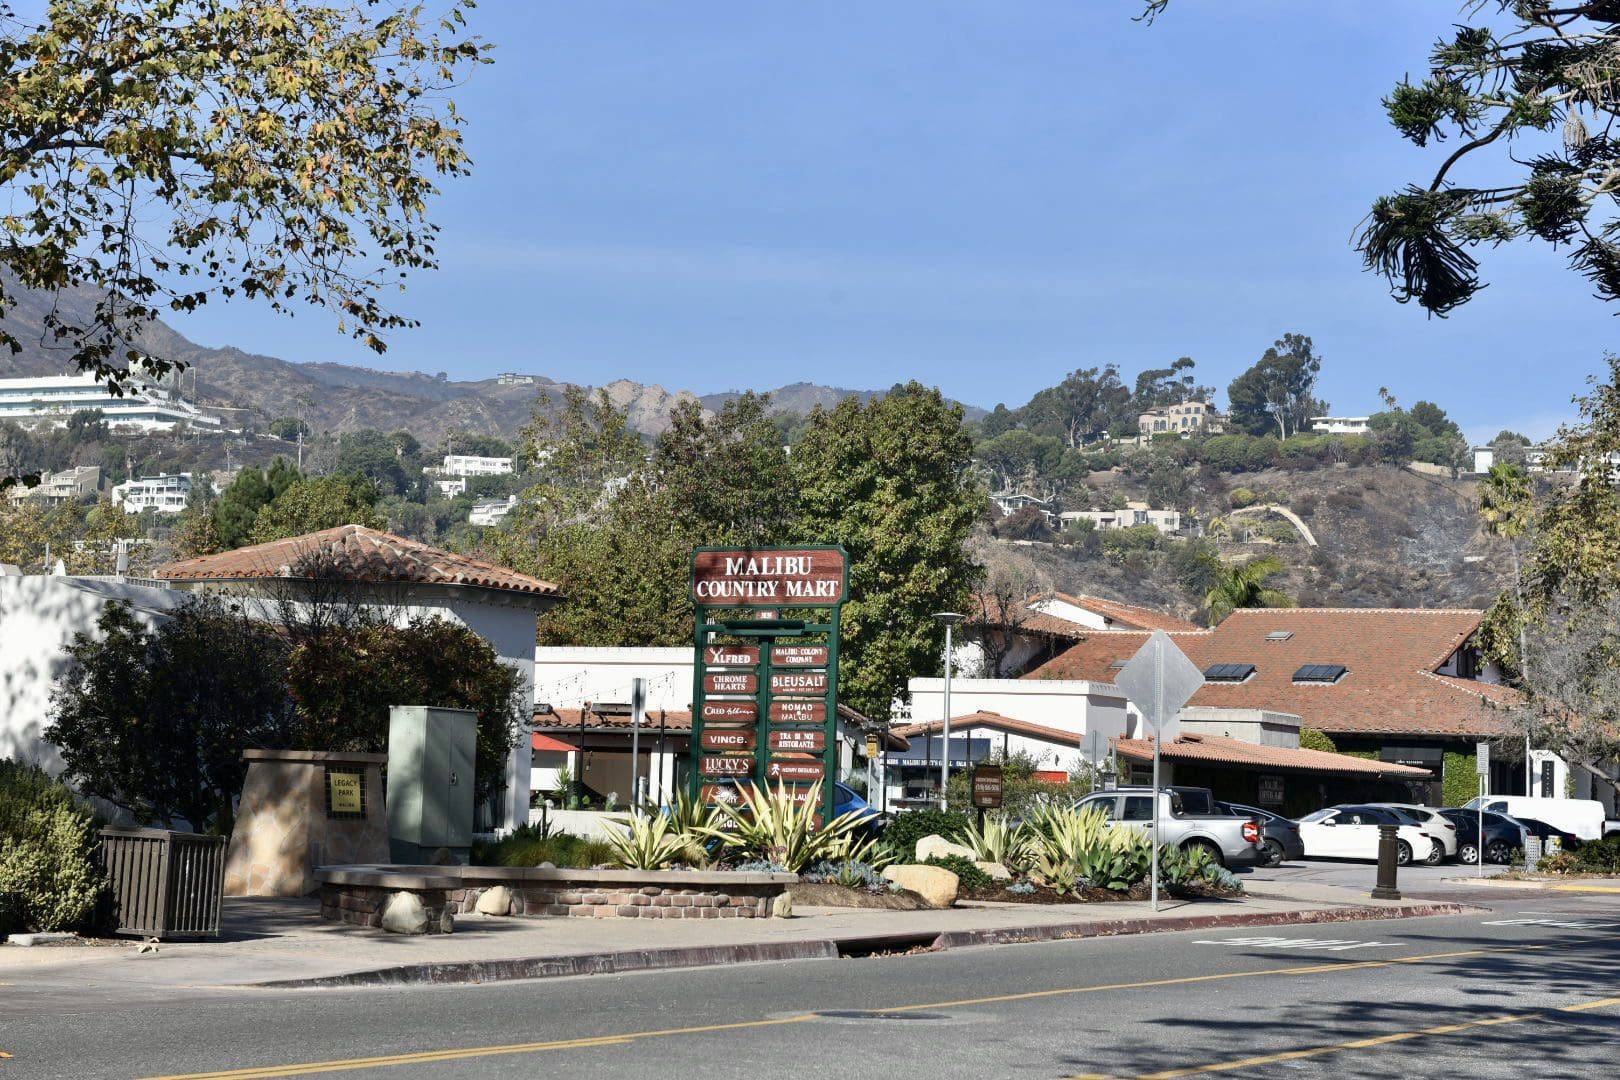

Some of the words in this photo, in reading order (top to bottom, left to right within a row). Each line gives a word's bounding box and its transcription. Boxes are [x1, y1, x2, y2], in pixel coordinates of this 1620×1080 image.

[725, 556, 813, 576] MALIBU
[696, 580, 779, 597] COUNTRY
[785, 580, 839, 597] MART
[710, 648, 751, 664] ALFRED
[775, 648, 798, 656] MALIBU
[785, 655, 813, 664] COMPANY
[712, 675, 748, 683] CHROME
[772, 676, 825, 687] BLEUSALT
[714, 683, 746, 691] HEARTS
[782, 703, 813, 711] NOMAD
[710, 735, 748, 744] VINCe.
[779, 732, 791, 740] TRA
[804, 732, 814, 740] NOI
[705, 758, 749, 770] LUCKY'S
